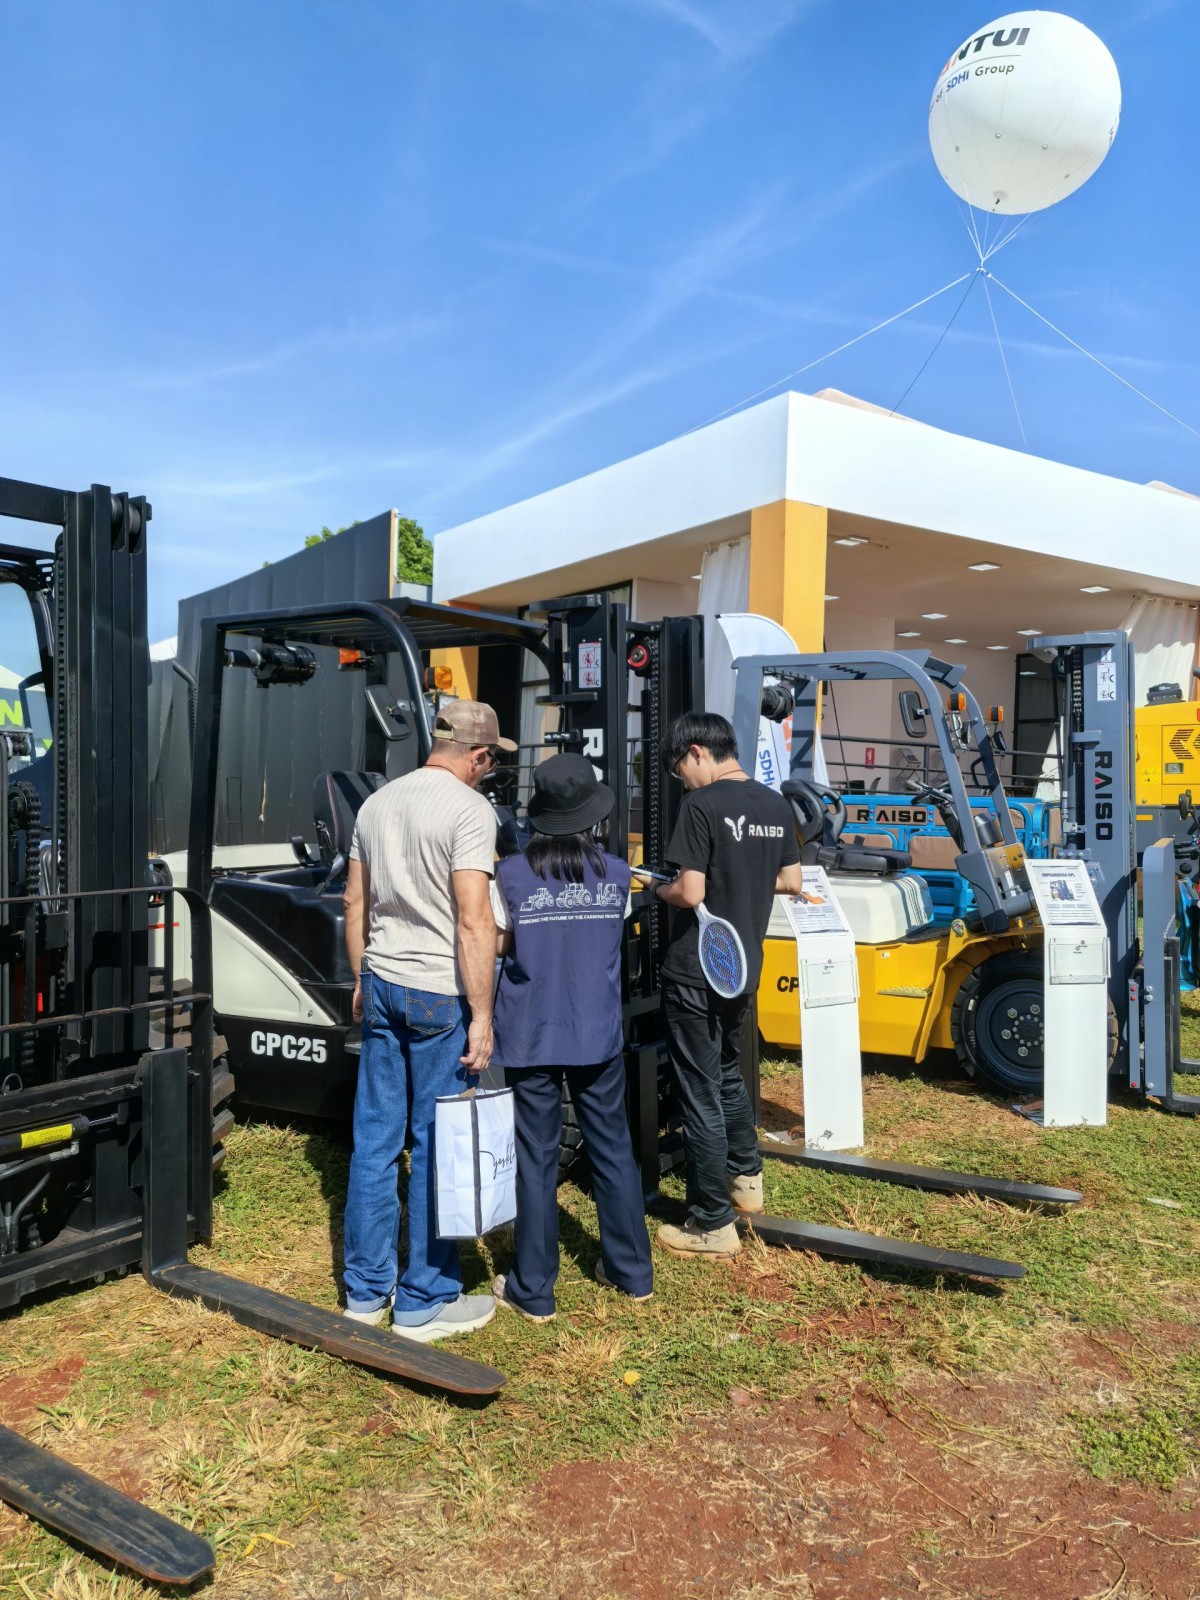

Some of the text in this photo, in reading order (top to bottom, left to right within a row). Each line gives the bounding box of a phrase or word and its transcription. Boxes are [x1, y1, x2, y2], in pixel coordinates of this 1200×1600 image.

[946, 70, 970, 92] SDHI
[974, 64, 1015, 77] Group
[1095, 751, 1113, 841] RAISO
[857, 809, 927, 823] RAISO
[748, 824, 784, 838] RAISO
[251, 1030, 327, 1064] CPC25
